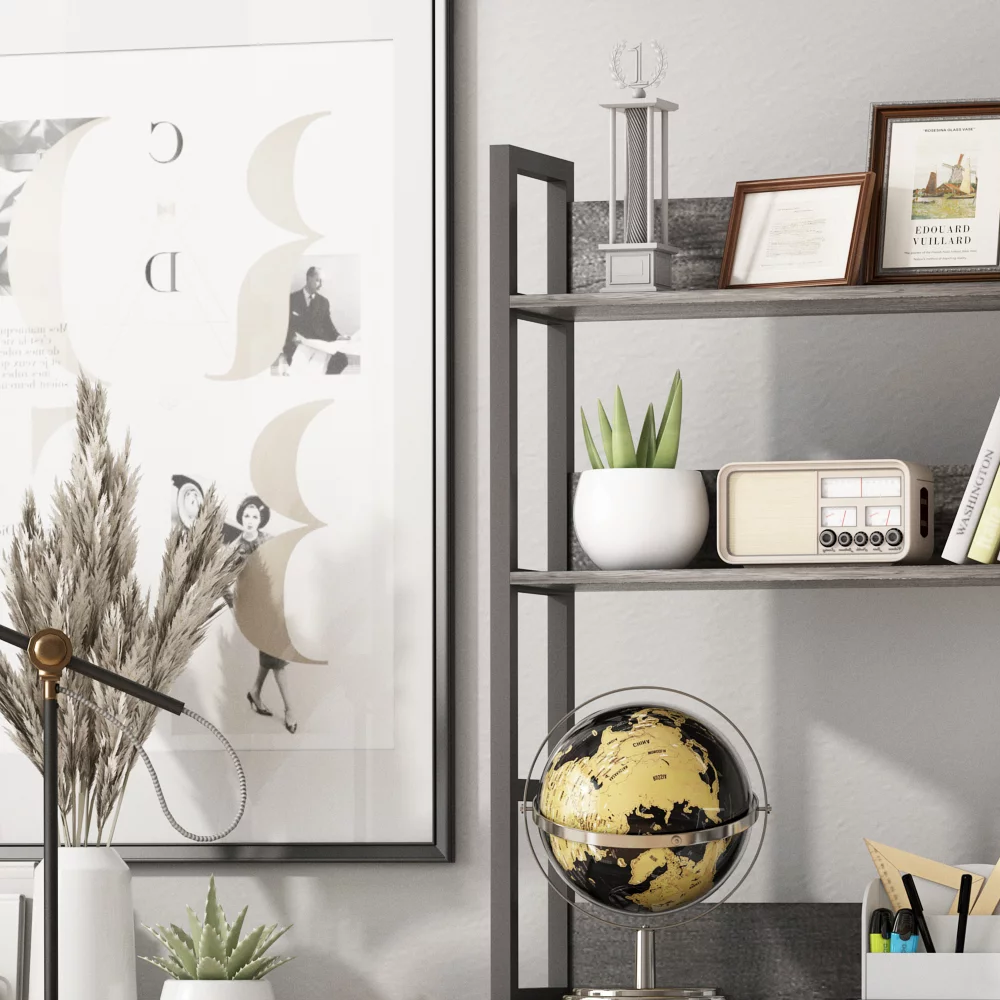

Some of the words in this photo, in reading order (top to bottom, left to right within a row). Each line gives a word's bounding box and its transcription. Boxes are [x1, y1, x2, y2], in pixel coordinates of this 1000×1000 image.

[915, 224, 970, 235] EDOUARD
[913, 235, 972, 245] VUILLARD
[956, 449, 995, 536] WASHINGTON
